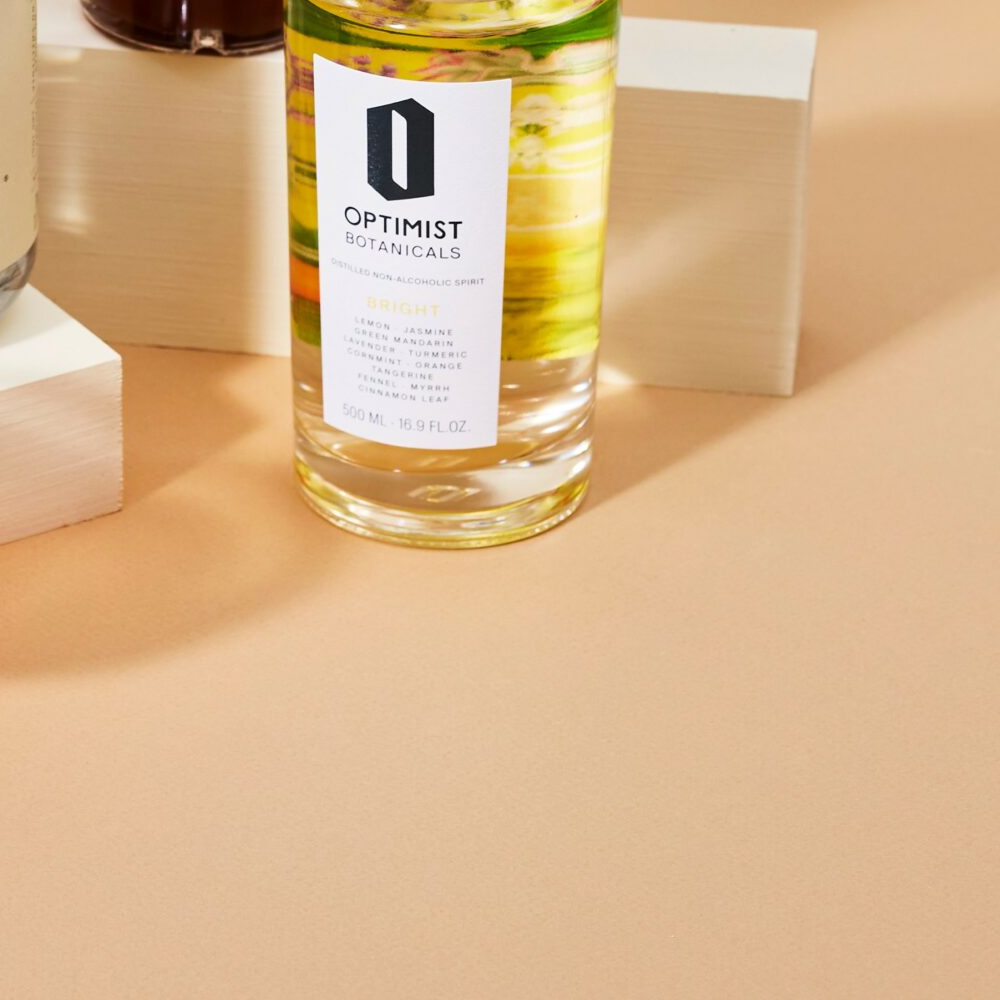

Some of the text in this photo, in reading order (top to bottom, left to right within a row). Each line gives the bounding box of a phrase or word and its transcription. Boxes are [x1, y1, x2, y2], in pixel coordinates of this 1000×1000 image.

[343, 206, 463, 240] OPTIMIST
[345, 231, 461, 260] BOTANICALS
[330, 257, 486, 287] DISTILLED NON-ALCOHOLIC SPIRIT
[365, 296, 441, 318] BRIGHT
[354, 327, 454, 347] GREEN MANDARIN
[355, 316, 454, 337] LEMON JASMINE
[343, 334, 468, 359] LAVENDER TURMERIC
[347, 346, 463, 370] CORNMINT ORANGE
[358, 373, 450, 392] FENNEL MYRRH
[371, 365, 434, 381] TANGERINE
[358, 384, 449, 403] CINNAMON LEAF
[342, 403, 366, 422] 500
[368, 411, 387, 427] ML
[398, 417, 426, 432] 16.9
